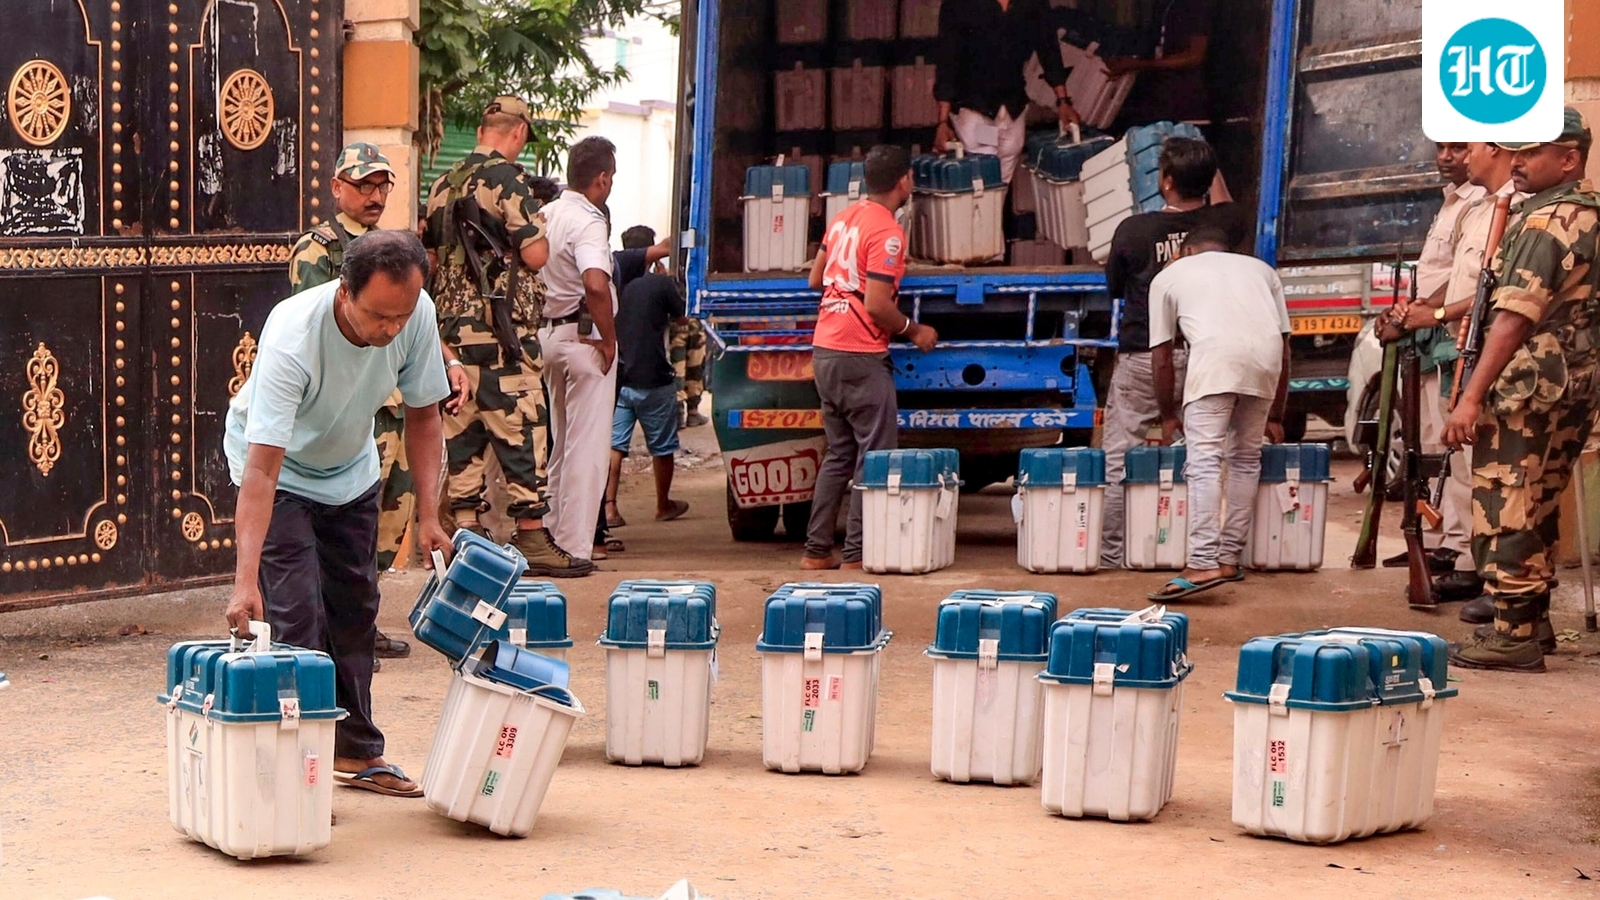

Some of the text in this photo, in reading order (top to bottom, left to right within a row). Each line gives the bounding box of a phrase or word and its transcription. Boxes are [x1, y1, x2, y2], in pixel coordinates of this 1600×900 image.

[313, 234, 328, 245] BSF
[823, 221, 860, 292] 29
[1304, 318, 1317, 331] 19
[1321, 318, 1327, 330] T
[1330, 317, 1359, 330] 4342
[746, 410, 817, 428] STOP
[734, 456, 817, 494] GOOD
[805, 680, 811, 691] OK
[496, 726, 509, 756] FLC OK
[506, 727, 517, 748] 3309
[1271, 741, 1277, 754] OK
[485, 785, 494, 796] 183
[1276, 795, 1284, 807] 183
